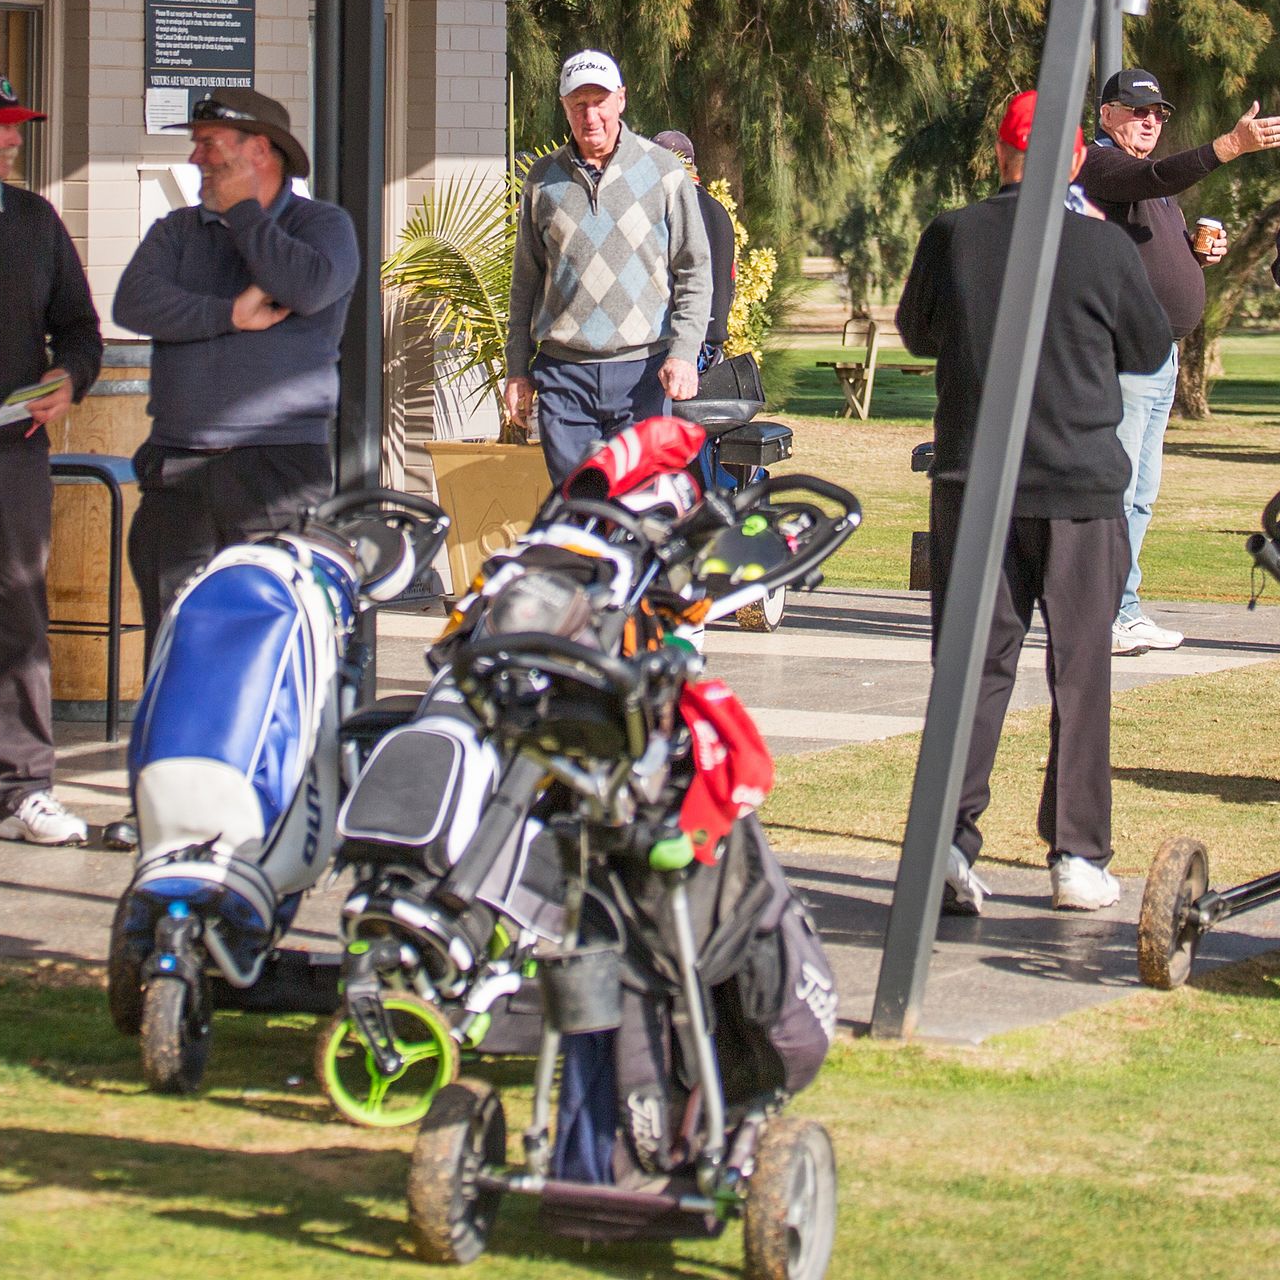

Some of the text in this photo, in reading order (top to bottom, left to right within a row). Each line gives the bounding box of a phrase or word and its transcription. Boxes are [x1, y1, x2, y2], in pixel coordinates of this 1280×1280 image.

[566, 61, 607, 77] Titleist
[151, 75, 169, 85] VISITORS
[170, 76, 179, 86] ARE
[180, 76, 200, 86] WELCOME
[201, 77, 208, 87] TO
[216, 77, 225, 87] OUR
[226, 78, 236, 87] CLUB
[236, 78, 251, 88] HOUSE
